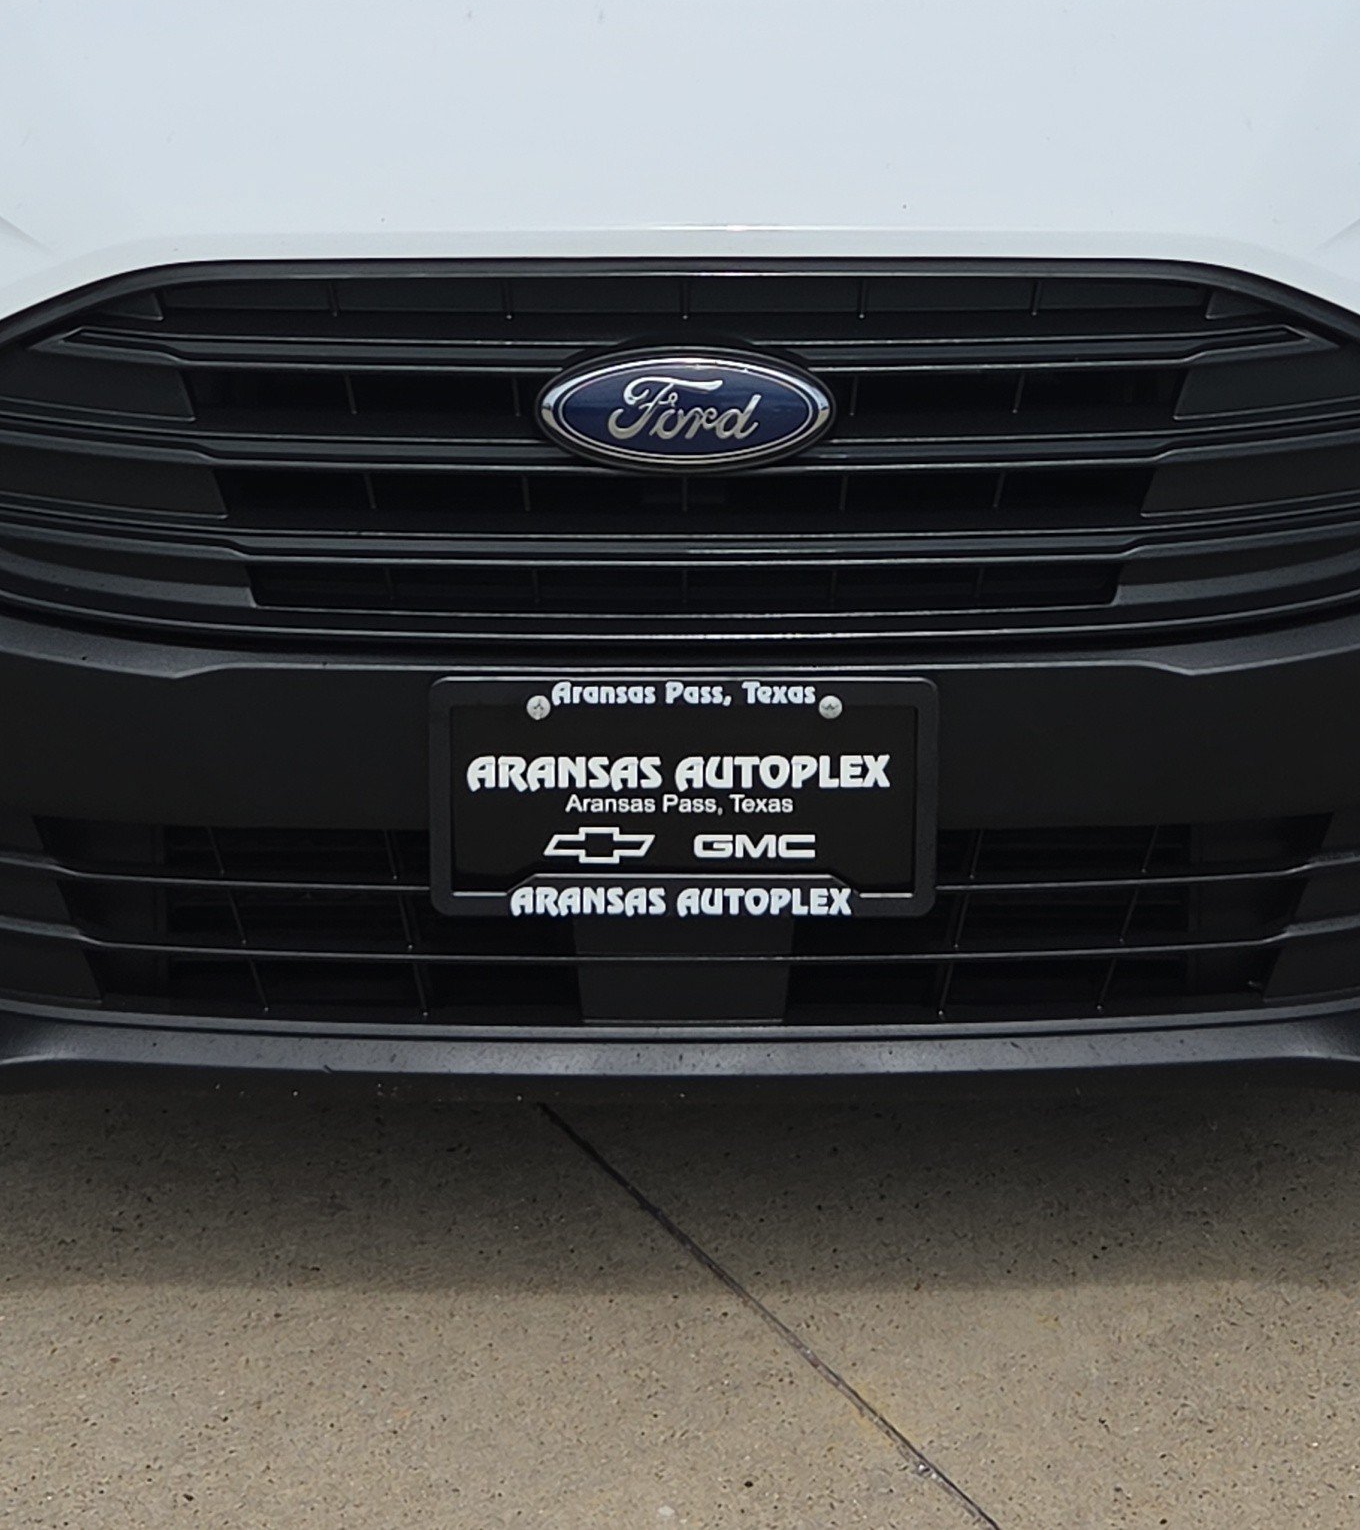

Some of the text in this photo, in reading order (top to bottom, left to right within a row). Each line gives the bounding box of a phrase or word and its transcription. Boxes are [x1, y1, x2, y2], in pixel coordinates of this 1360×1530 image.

[607, 376, 762, 440] Ford
[551, 681, 817, 707] Aransas Pass, Texas
[466, 754, 891, 793] ARANSAS AUTOPLEX
[564, 794, 794, 816] Aransas Pass, Texas
[693, 834, 817, 859] GMC
[510, 887, 853, 918] ARANSAS AUTOPLEX
